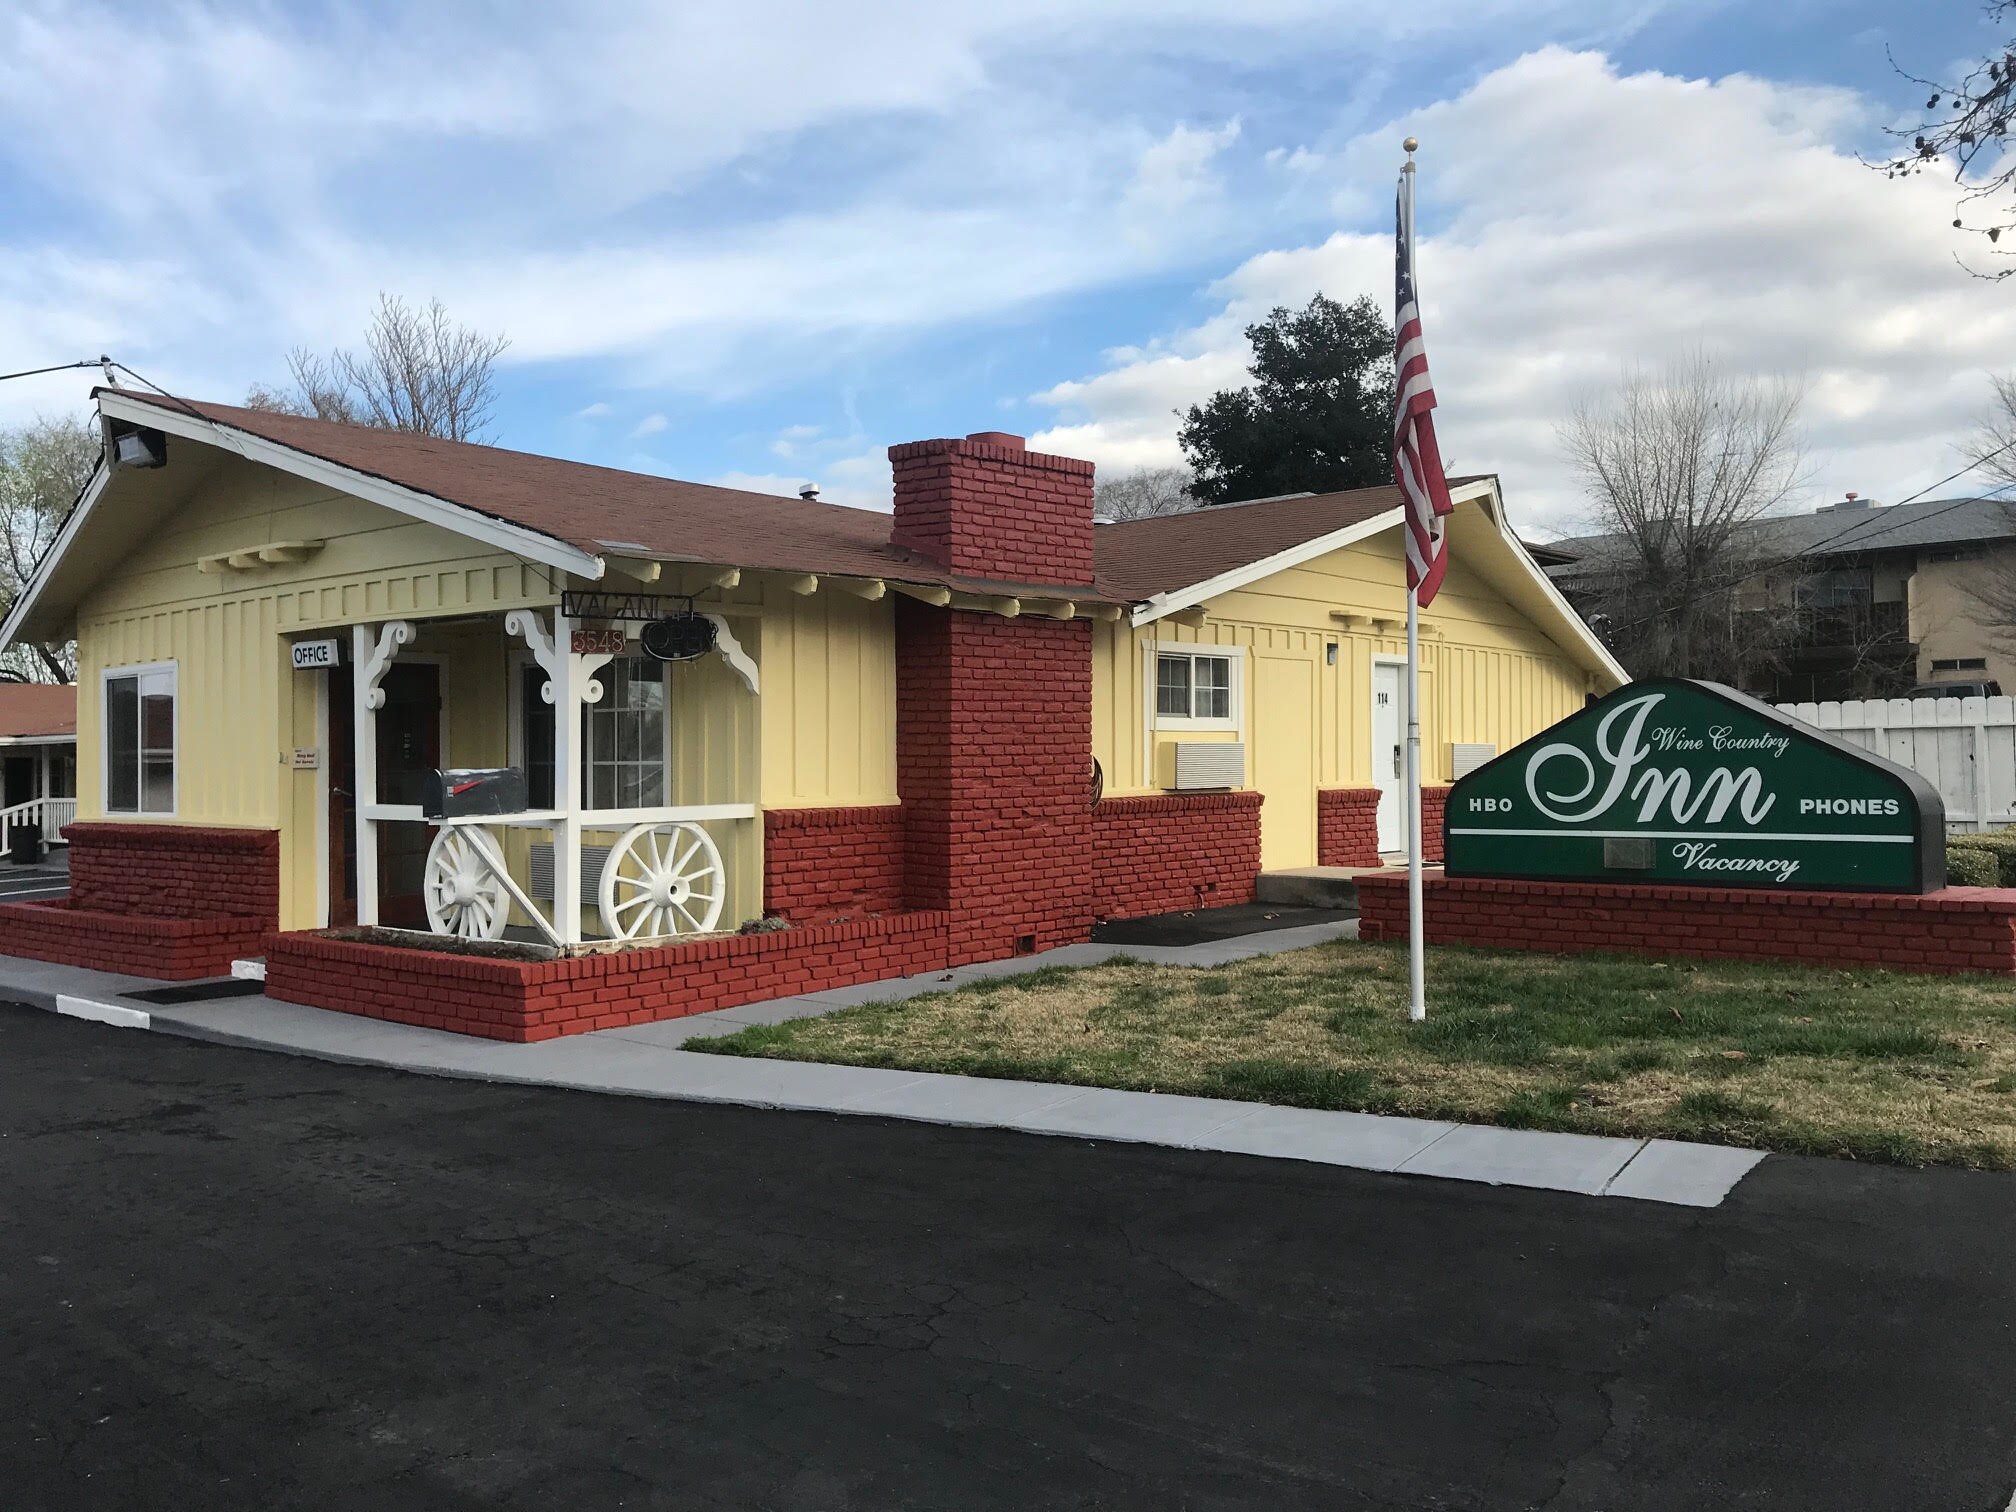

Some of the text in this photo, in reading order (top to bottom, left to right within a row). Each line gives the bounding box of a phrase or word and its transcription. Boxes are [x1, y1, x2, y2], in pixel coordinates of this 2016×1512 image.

[573, 630, 624, 652] 3548
[294, 645, 328, 664] OFFICE
[1377, 692, 1388, 705] 114
[1651, 725, 1790, 758] Wine Country
[1525, 693, 1777, 826] Inn
[1469, 797, 1513, 812] HBO
[1800, 798, 1900, 815] PHONES
[1672, 842, 1800, 883] Vacancy
